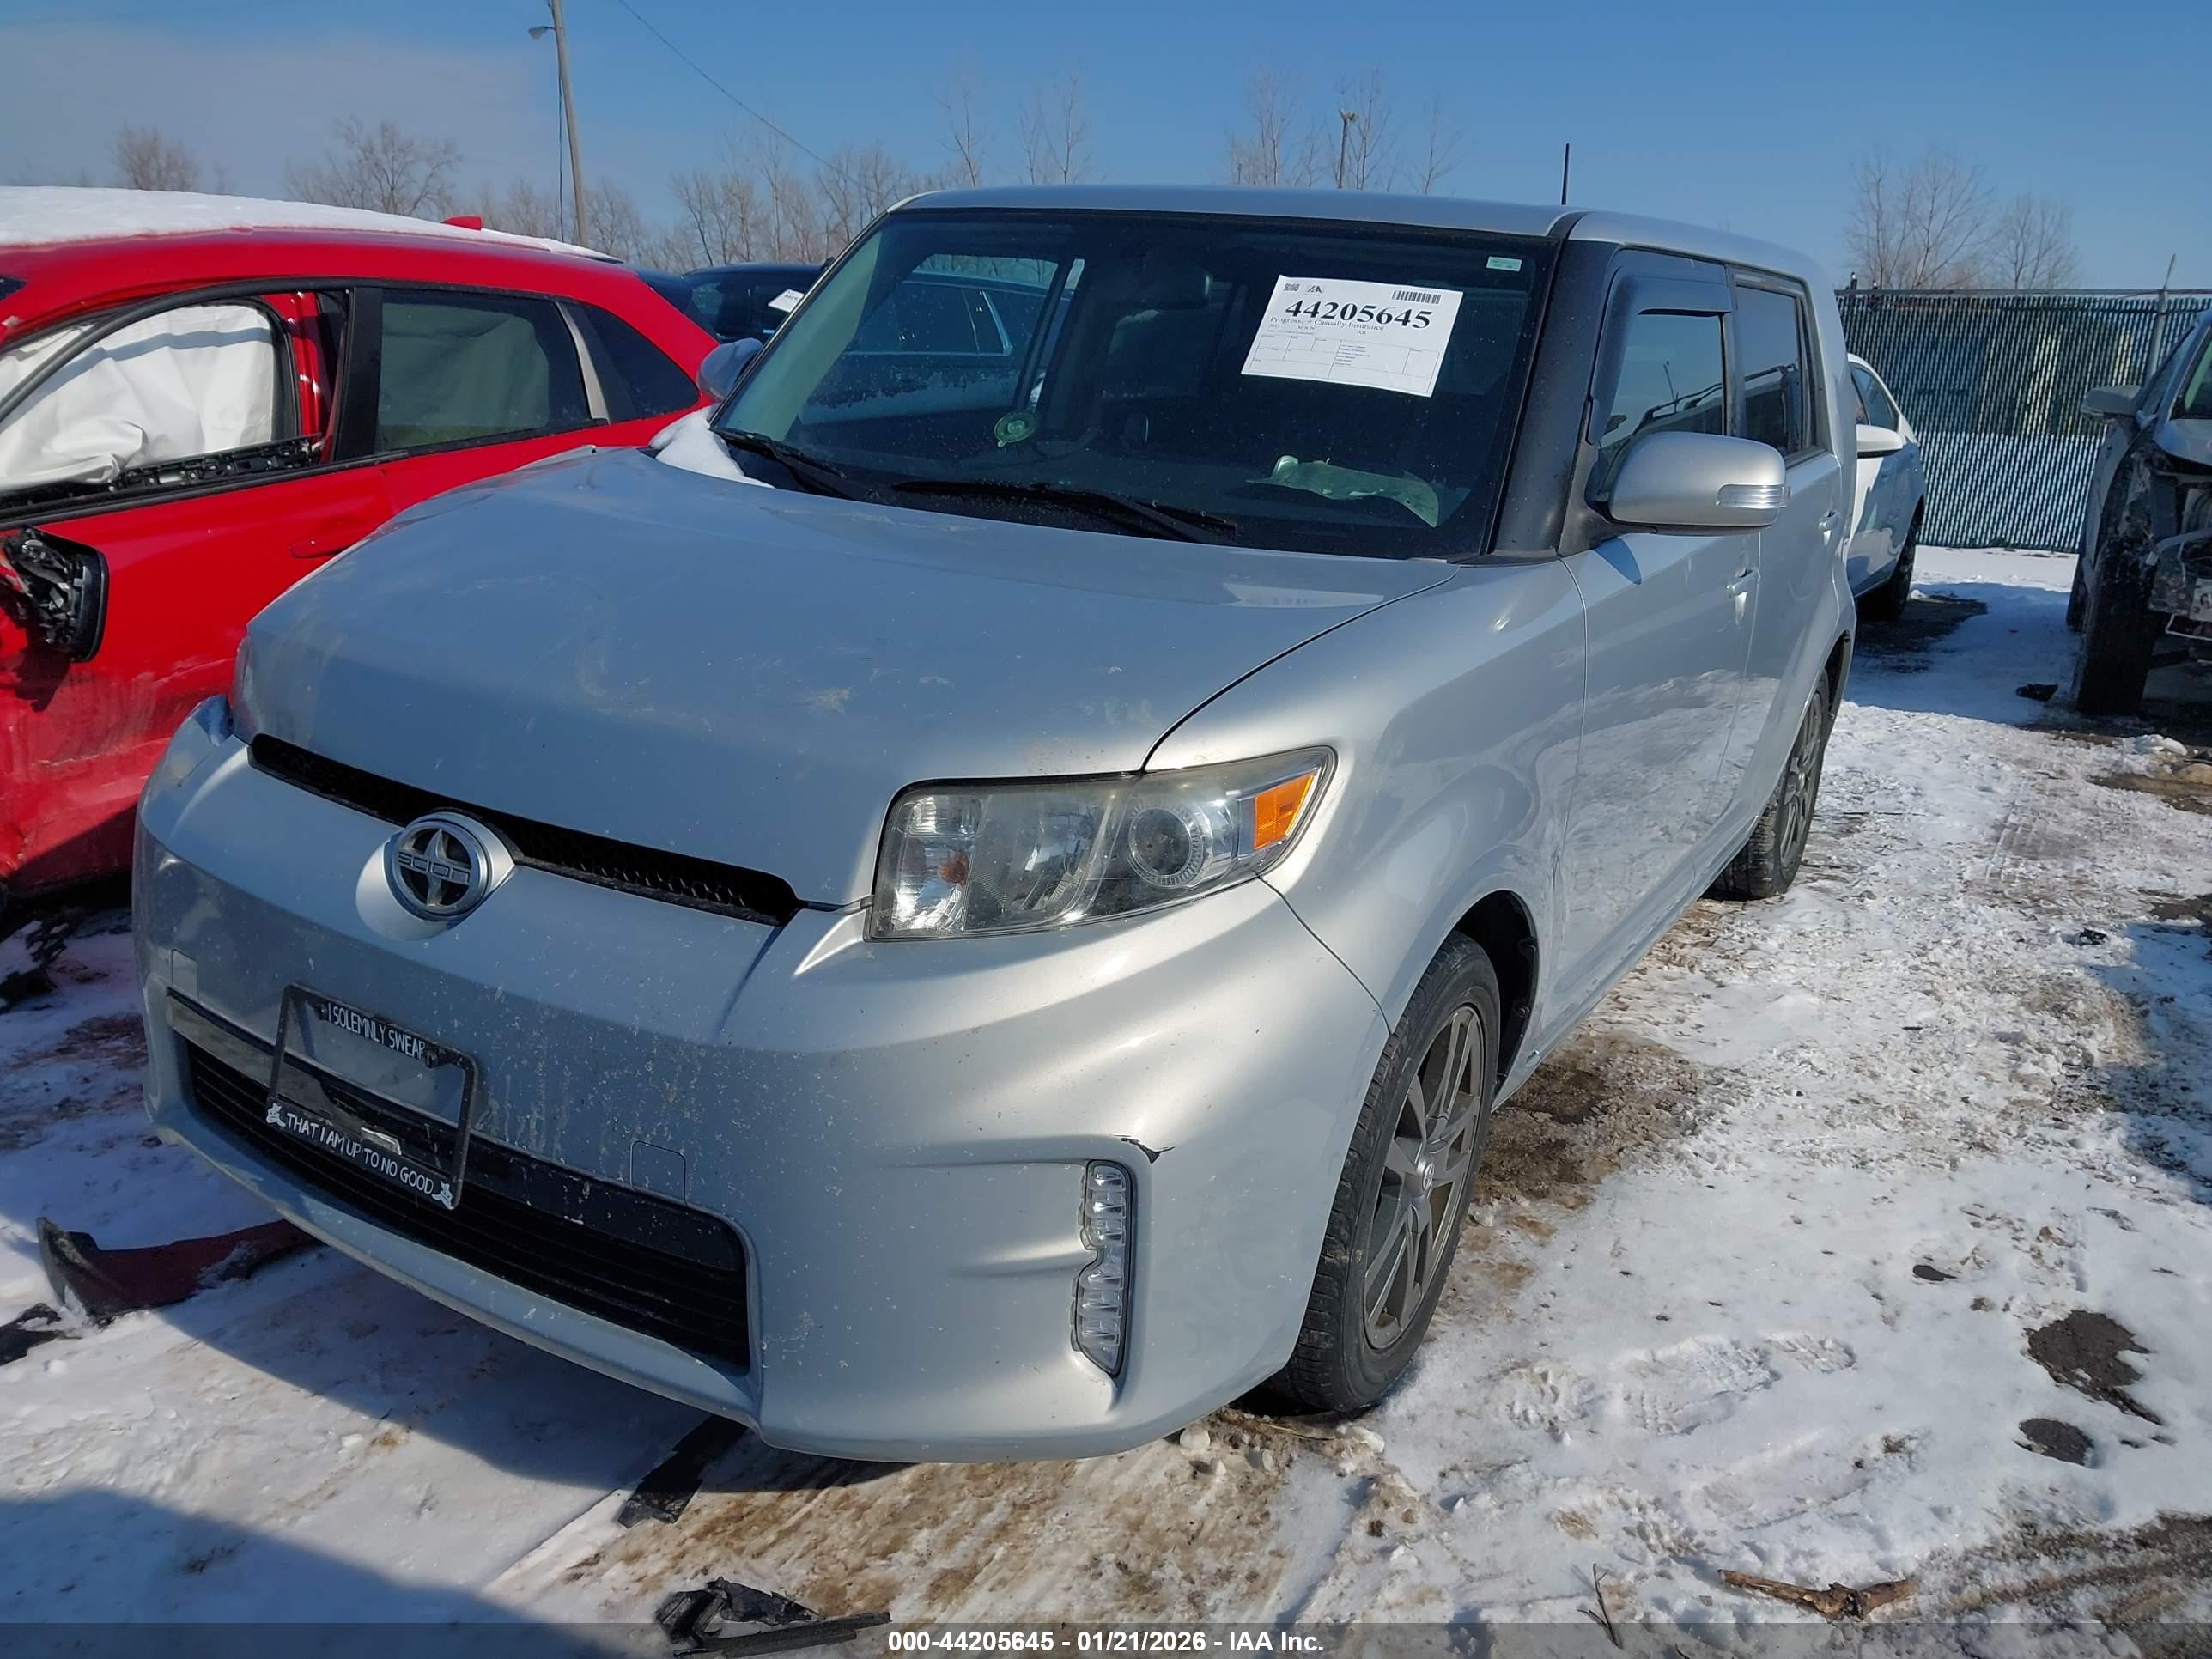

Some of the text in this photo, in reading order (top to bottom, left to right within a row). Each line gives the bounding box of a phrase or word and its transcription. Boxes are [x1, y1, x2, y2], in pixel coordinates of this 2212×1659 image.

[1285, 300, 1432, 329] 44205645
[1314, 319, 1346, 328] Casualty
[1348, 322, 1385, 331] Insurance
[328, 1002, 331, 1022] I
[332, 1006, 386, 1044] SOLEMNLY
[287, 1112, 434, 1194] THAT I AM UP TO NO GOOD
